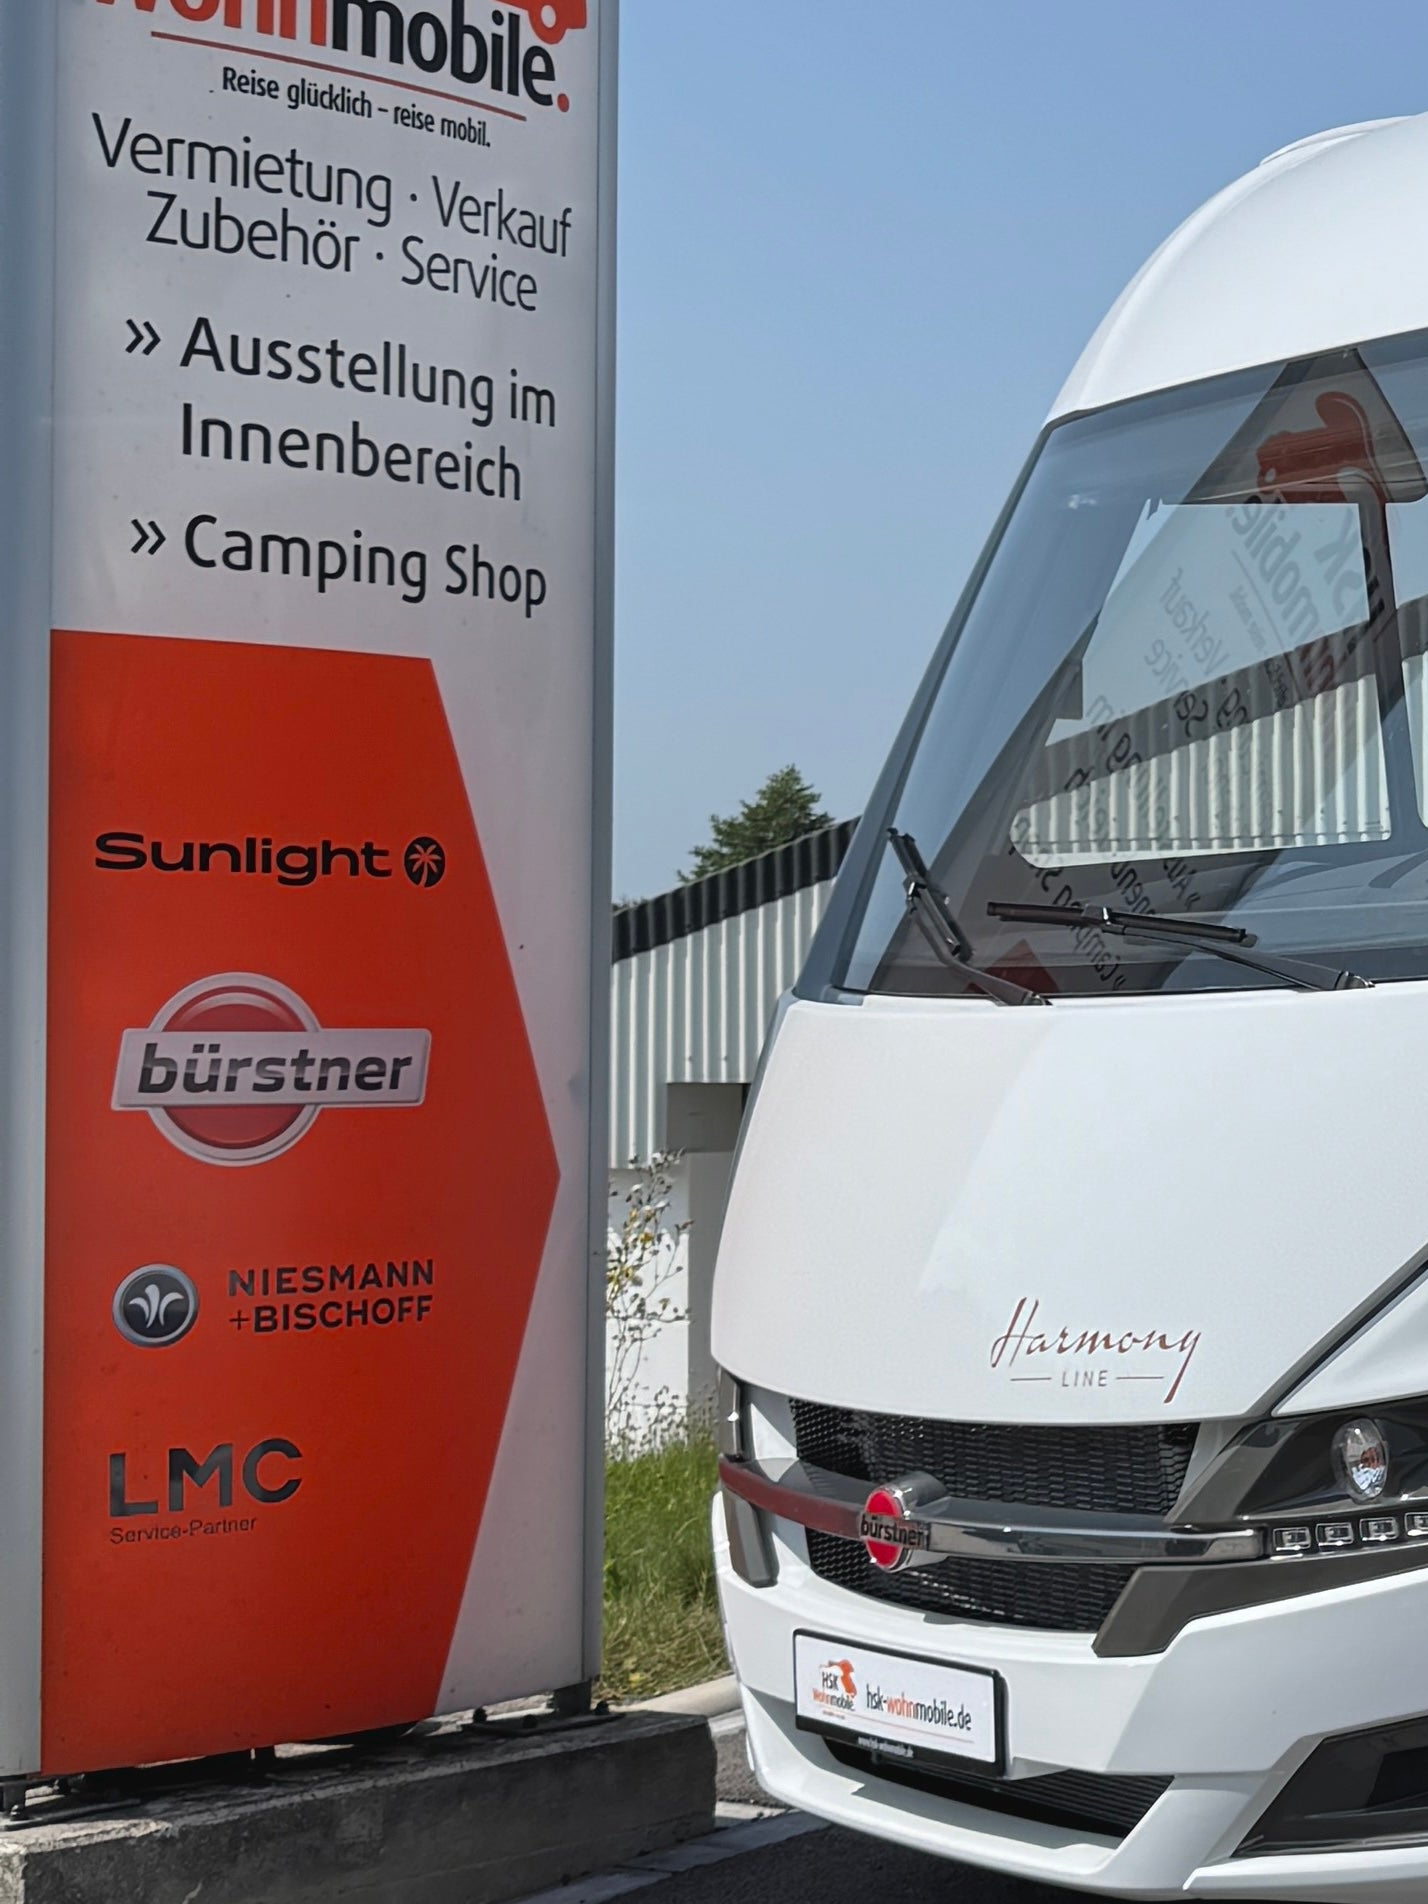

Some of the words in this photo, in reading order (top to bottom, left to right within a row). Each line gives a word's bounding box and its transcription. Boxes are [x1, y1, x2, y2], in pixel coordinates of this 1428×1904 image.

[222, 66, 279, 99] Reise
[287, 78, 372, 118] glücklich
[393, 103, 435, 133] reise
[440, 116, 491, 148] mobil.
[92, 112, 393, 227] Vermietung
[432, 175, 573, 258] Verkauf
[146, 191, 361, 273] Zubehör
[401, 236, 538, 311] Service
[180, 317, 494, 427] Ausstellung
[509, 369, 557, 427] im
[182, 403, 521, 501] Innenbereich
[184, 514, 426, 604] Camping
[445, 544, 547, 618] Shop
[95, 832, 393, 886] Sunlight
[137, 1043, 412, 1094] bürstner
[228, 1259, 435, 1297] NIESMANN
[991, 1297, 1202, 1404] Harmony
[1061, 1370, 1108, 1387] LINE
[110, 1438, 303, 1517] LMC
[110, 1516, 257, 1545] Service-Partner
[861, 1514, 924, 1547] bürstner
[822, 1671, 839, 1691] HSK
[866, 1683, 972, 1731] hsk-wohnmobile.de
